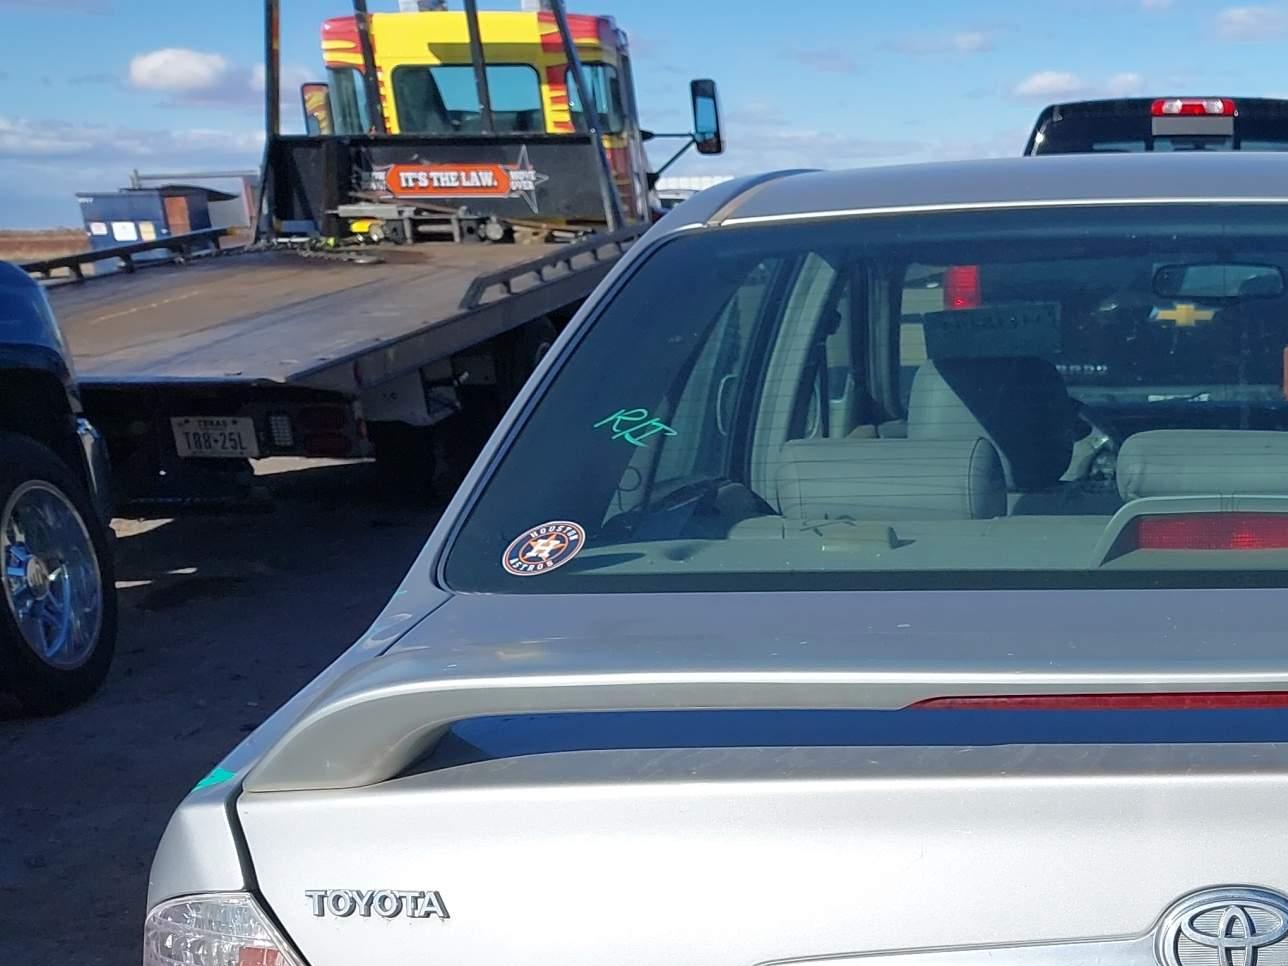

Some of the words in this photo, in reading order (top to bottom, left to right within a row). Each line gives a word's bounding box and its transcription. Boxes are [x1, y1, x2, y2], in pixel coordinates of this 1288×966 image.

[399, 171, 429, 187] IT'S
[429, 171, 460, 187] THE
[461, 171, 498, 187] LAW.
[530, 525, 579, 541] HOUSTON
[509, 558, 554, 572] ASTROS
[304, 889, 451, 919] TOYOTA
